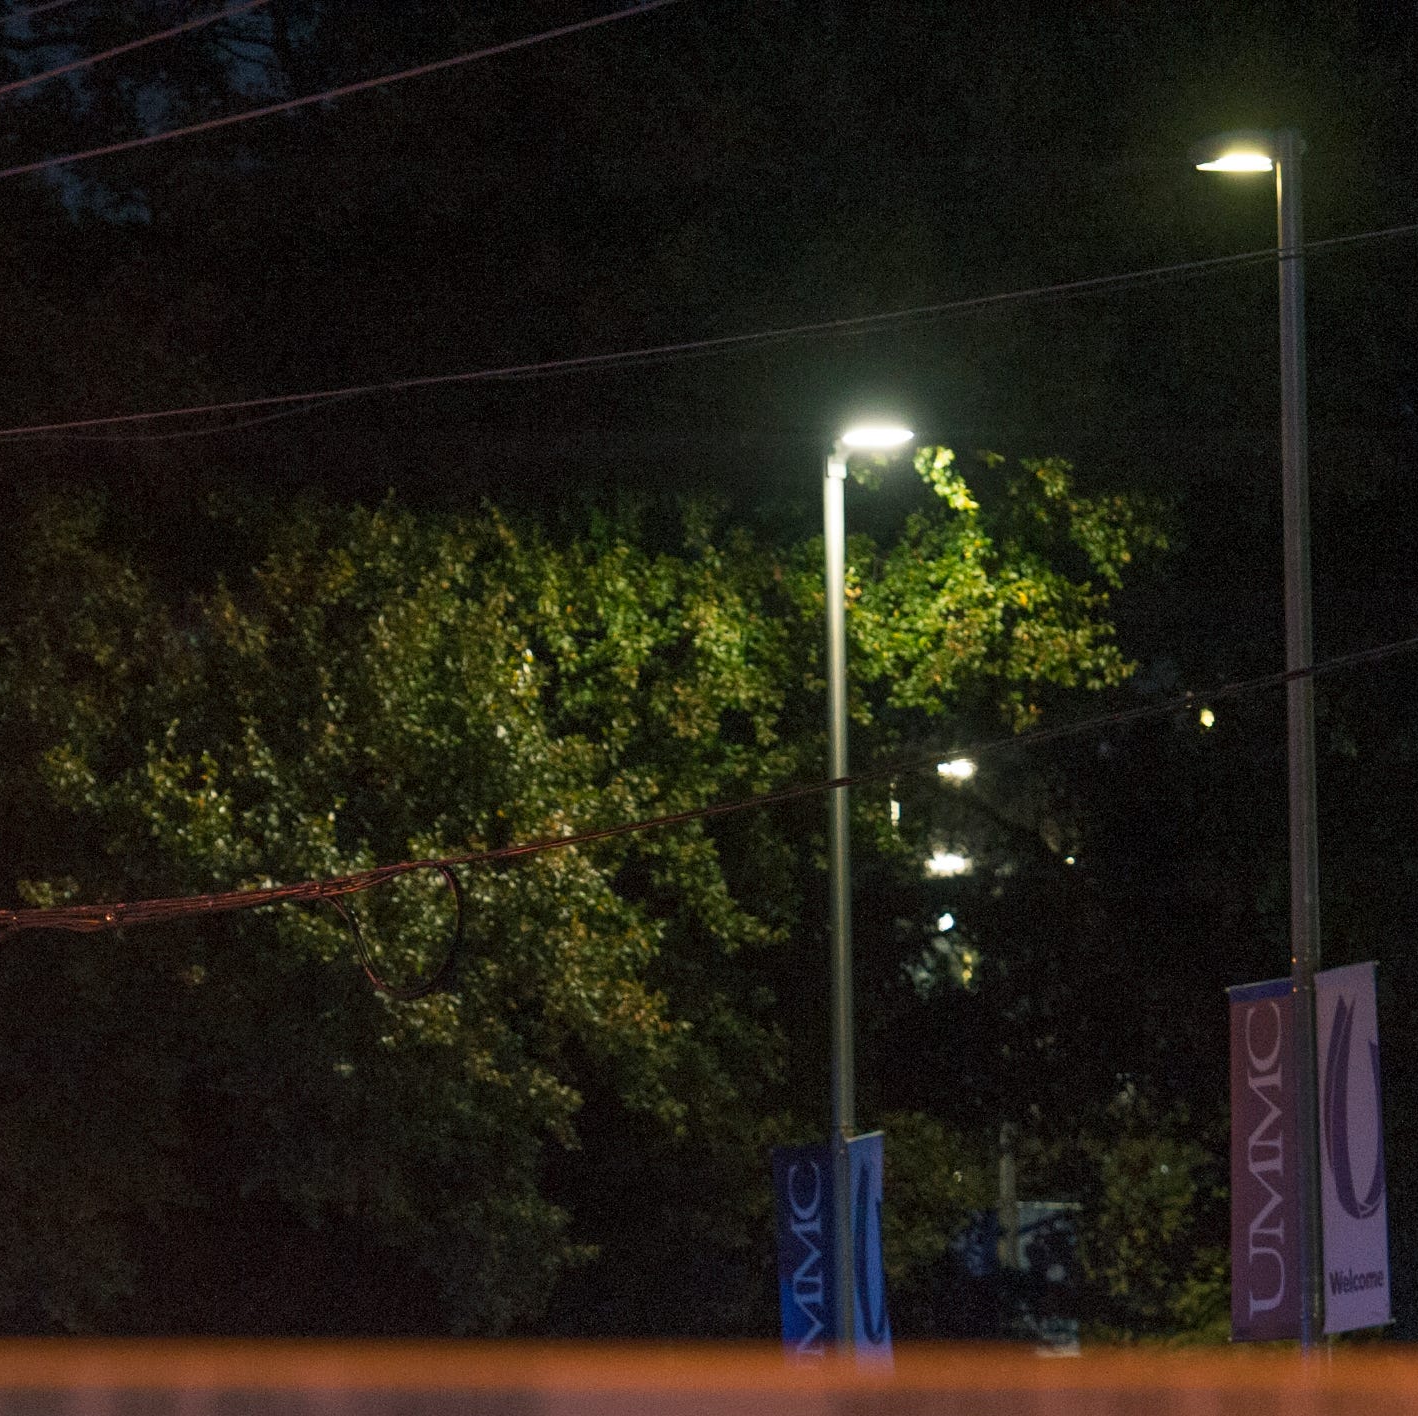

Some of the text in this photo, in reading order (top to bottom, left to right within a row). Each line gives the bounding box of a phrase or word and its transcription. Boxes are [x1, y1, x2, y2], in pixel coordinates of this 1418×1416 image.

[788, 1160, 825, 1357] MMC
[1245, 1001, 1286, 1320] UMMC
[1329, 1268, 1384, 1295] Welcome
